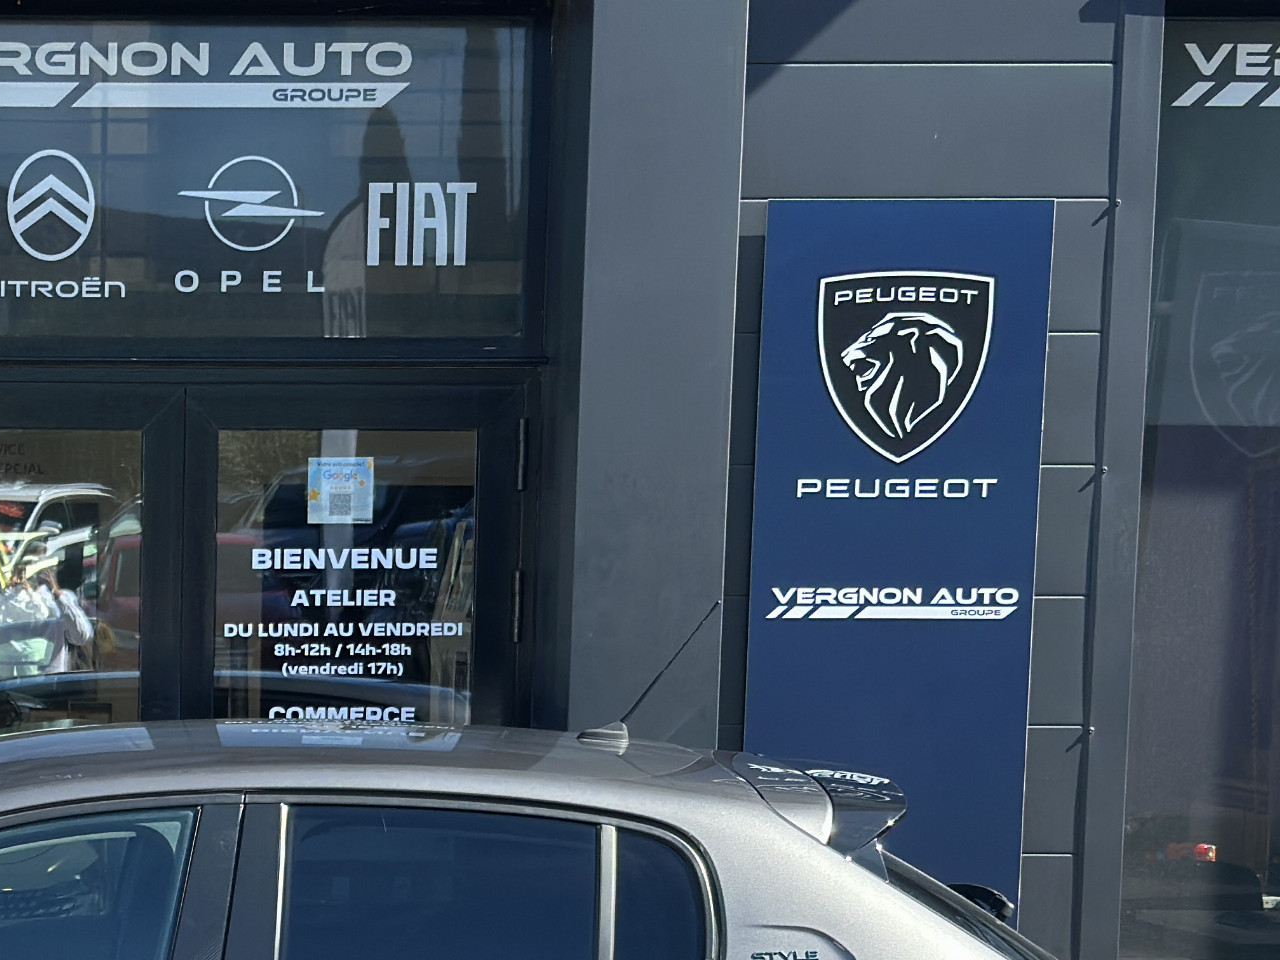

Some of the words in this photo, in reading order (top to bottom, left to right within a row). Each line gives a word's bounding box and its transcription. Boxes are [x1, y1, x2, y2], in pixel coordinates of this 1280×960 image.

[230, 42, 412, 76] AUTO
[1185, 44, 1280, 75] VE
[273, 89, 377, 101] GROUPE
[367, 182, 477, 266] FIAT
[834, 287, 978, 305] PEUGEOT
[323, 470, 358, 482] Google
[797, 479, 997, 497] PEUGEOT
[252, 548, 437, 569] BIENVENUE
[291, 589, 396, 606] ATELIER
[772, 588, 923, 606] VERGNON
[931, 588, 1019, 606] AUTO
[224, 623, 253, 637] DU
[258, 623, 318, 637] LUNDI
[324, 623, 353, 636] AU
[359, 623, 462, 636] VENDREDI
[274, 644, 330, 656] 8h-12h
[335, 644, 342, 657] /
[346, 643, 411, 655] 14h-18h
[282, 663, 363, 677] (vendredi
[368, 663, 403, 676] 17h)
[268, 706, 415, 721] COMMERCE
